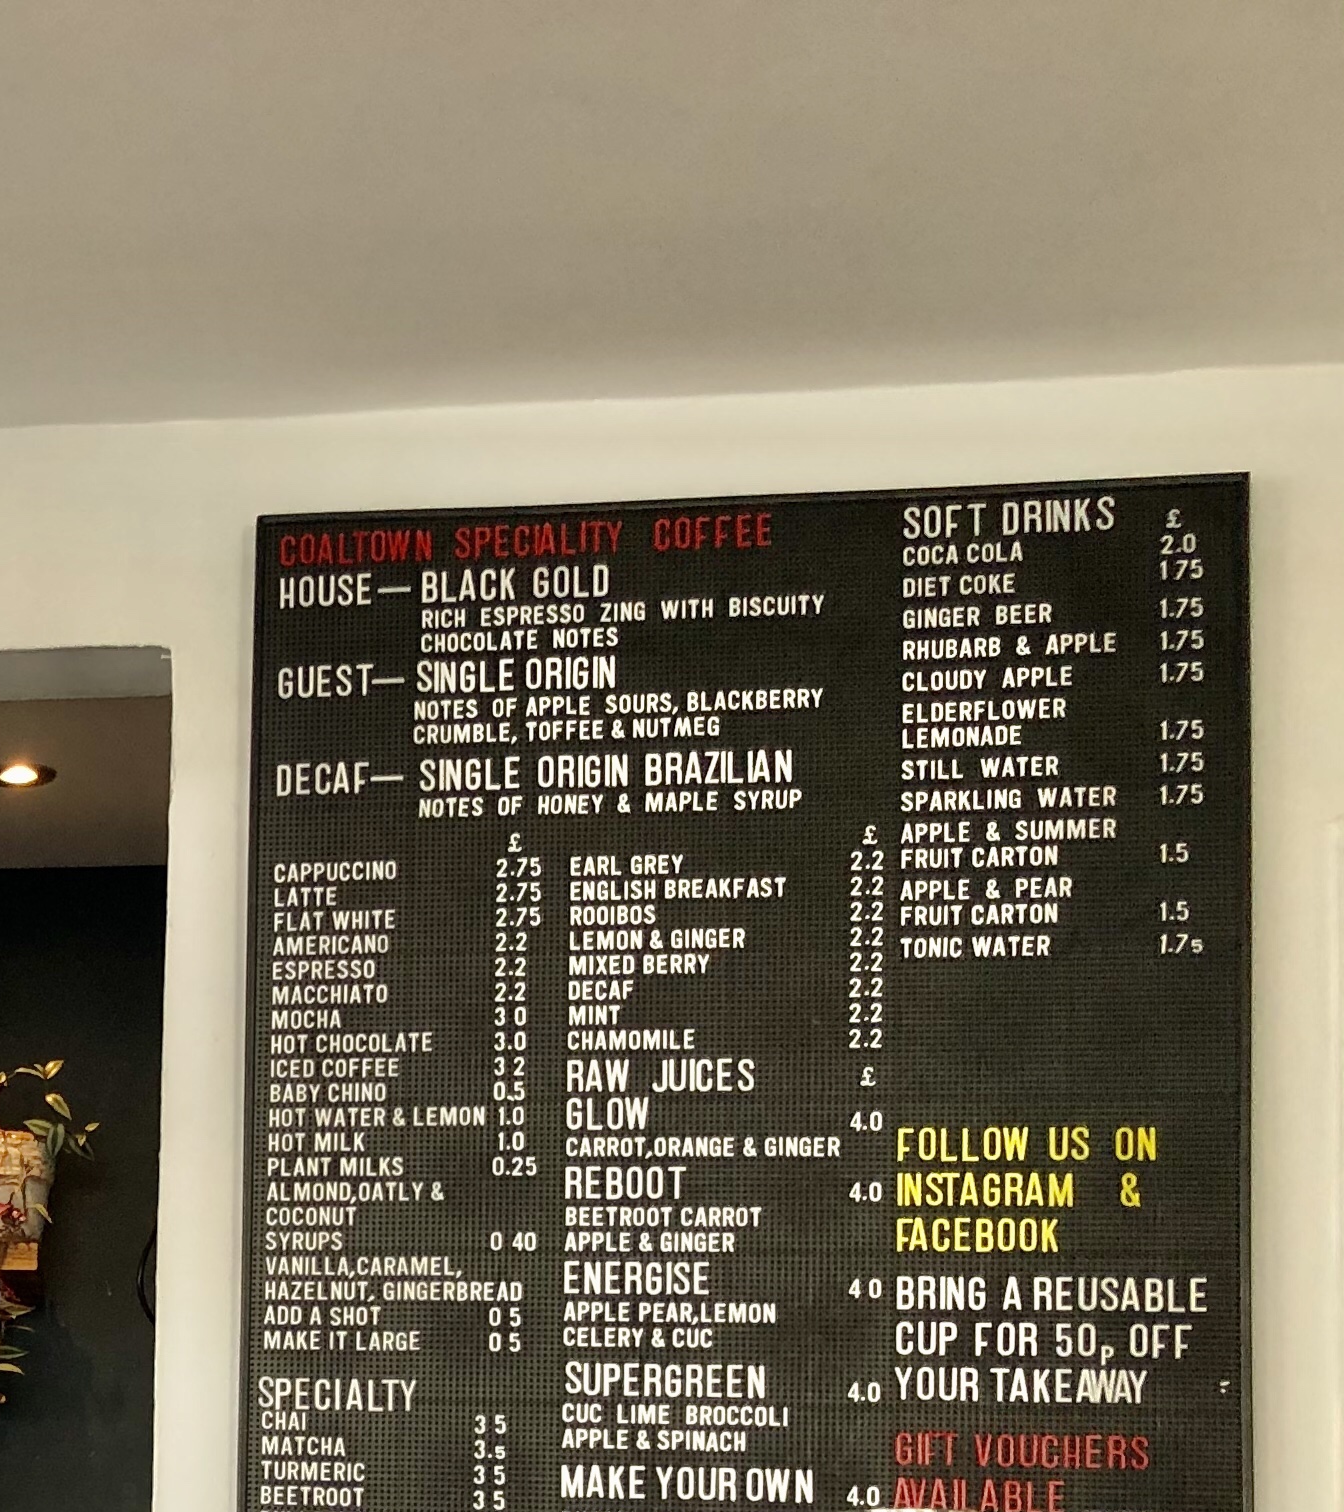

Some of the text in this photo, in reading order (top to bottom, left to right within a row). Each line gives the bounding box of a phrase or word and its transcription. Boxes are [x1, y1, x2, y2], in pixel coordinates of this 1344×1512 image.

[903, 495, 1115, 540] SOFT DRINKS
[279, 513, 769, 568] COALTOWN SPECIALITY COFFEE
[421, 564, 609, 604] BLACK GOLD
[421, 594, 825, 630] RICH ESPRESSO ZING WITH BISCUITY
[902, 603, 1052, 630] GINGER BEER
[1159, 597, 1204, 619] 1.75
[420, 626, 619, 653] CHOCOLATE NOTES
[416, 654, 616, 694] SINGLE ORIGIN
[414, 698, 479, 721] NOTES
[492, 697, 518, 718] OF
[525, 695, 591, 718] APPLE
[686, 687, 824, 713] BLACKBERRY
[902, 697, 1066, 724] ELDERFLOWER
[413, 715, 720, 745] CRUMBLE, TOFFEE & NUTMEG
[901, 724, 1022, 749] LEMONADE
[419, 748, 793, 792] SINGLE ORIGIN BRAZILIAN
[418, 788, 803, 819] NOTES OF HONEY & MAPLE SYRUP
[274, 860, 397, 884] CAPPUCCINO
[496, 856, 542, 878] 2.75
[272, 934, 389, 957] AMERICANO
[272, 983, 388, 1005] MACCHIATO
[566, 1057, 756, 1093] RAW JUICES
[566, 1096, 649, 1131] GLOW
[897, 1126, 1157, 1163] FOLLOW US ON
[564, 1165, 687, 1200] REBOOT
[896, 1171, 1141, 1208] INSTAGRAM &
[896, 1216, 1059, 1253] FACEBOOK
[563, 1260, 710, 1296] ENERGISE
[896, 1275, 1208, 1313] BRING A REUSABLE
[895, 1320, 958, 1357] CUP
[974, 1321, 1038, 1357] FOR
[1129, 1323, 1193, 1359] OFF
[258, 1375, 417, 1412] SPECIALTY
[564, 1360, 766, 1400] SUPERGREEN
[894, 1365, 1148, 1404] YOUR TAKEAWAY
[261, 1435, 346, 1457] MATCHA
[894, 1430, 1149, 1470] GIFT VOUCHERS
[260, 1460, 365, 1482] TURMERIC
[560, 1464, 814, 1504] MAKE YOUR OWN
